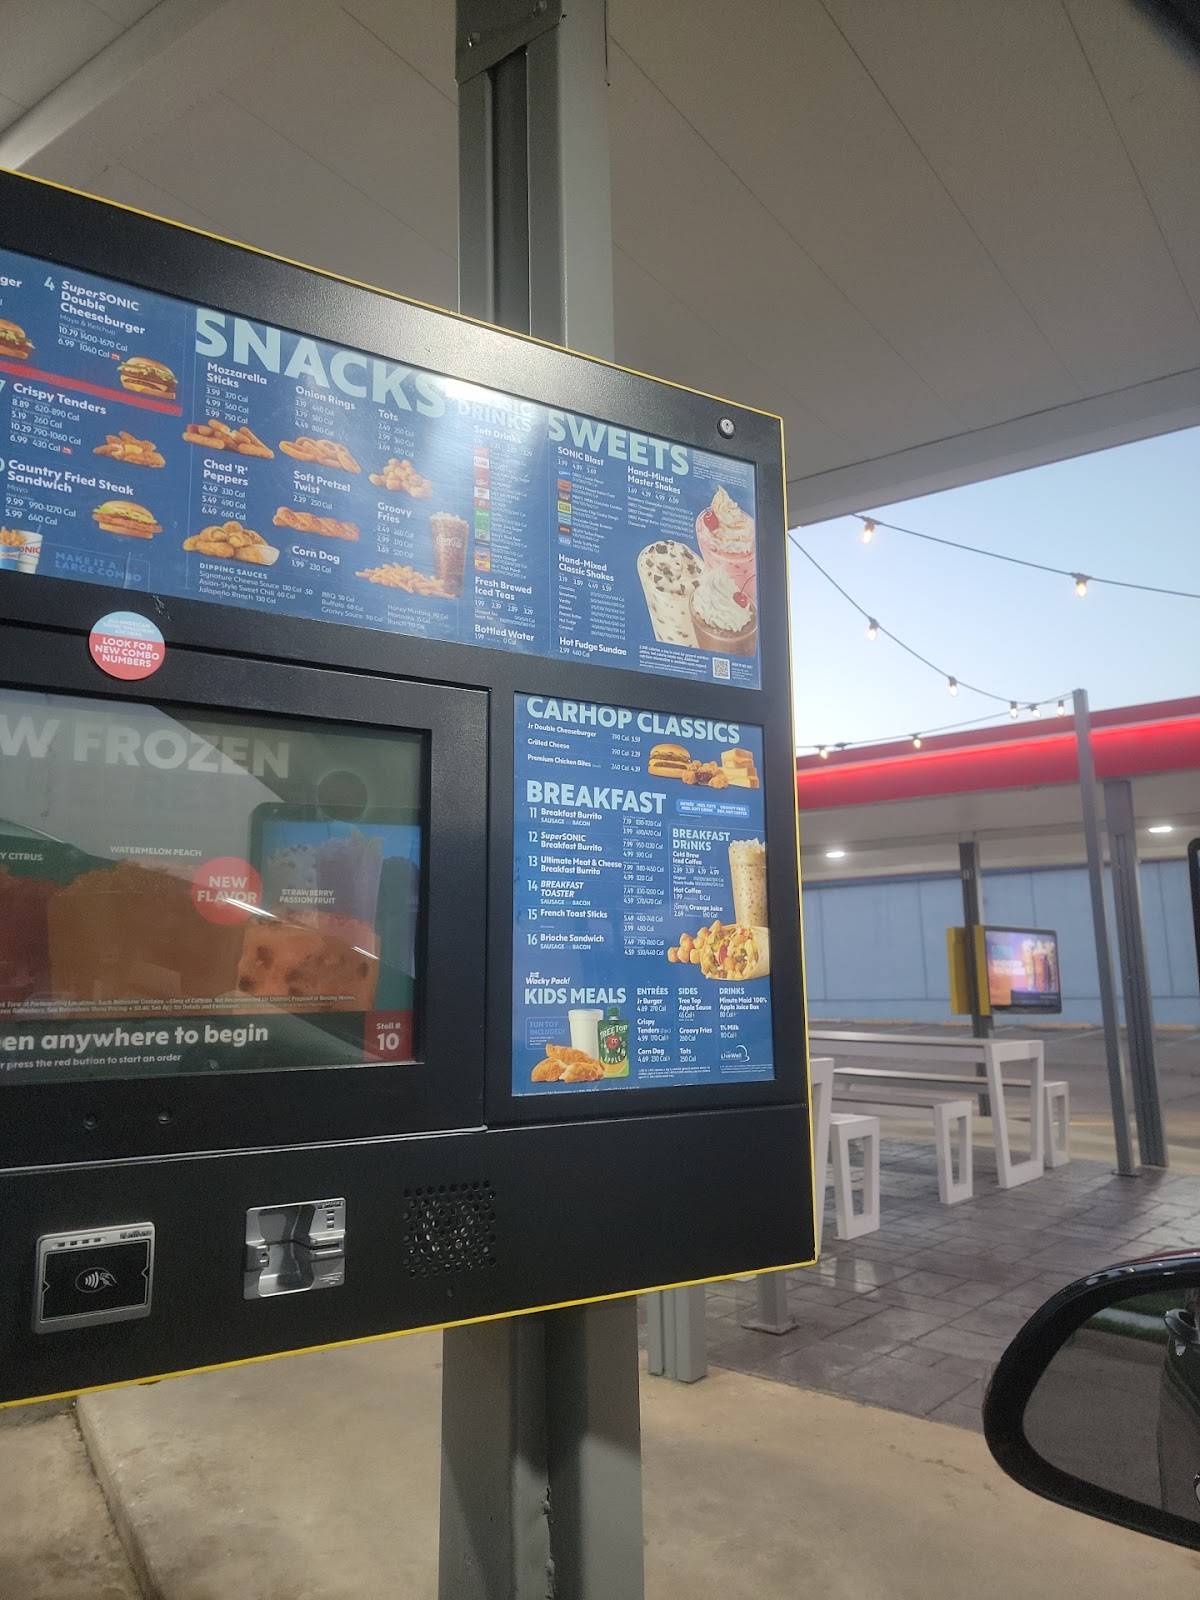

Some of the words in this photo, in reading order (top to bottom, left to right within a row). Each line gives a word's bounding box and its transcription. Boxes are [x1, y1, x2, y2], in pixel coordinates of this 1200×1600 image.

[43, 276, 55, 291] 4
[61, 280, 140, 312] SuperSONIC
[60, 291, 106, 313] Double
[60, 302, 146, 335] Cheeseburger
[195, 308, 447, 419] SNACKS
[206, 362, 268, 386] Mozzarella
[206, 373, 240, 390] Sticks
[13, 382, 55, 407] Crispy
[57, 389, 107, 415] Tenders
[295, 385, 326, 403] Onion
[328, 394, 356, 411] Rings
[378, 408, 400, 422] Tots
[547, 411, 690, 476] SWEETS
[557, 446, 585, 462] SONIC
[584, 454, 605, 467] Blast
[203, 459, 232, 474] Ched
[234, 462, 248, 475] 'R'
[627, 466, 674, 484] Hand-Mixed
[7, 471, 73, 494] Sandwich
[8, 458, 62, 481] Country
[64, 471, 96, 488] Fried
[98, 479, 135, 497] Steak
[203, 469, 249, 487] Peppers
[294, 470, 315, 484] Soft
[316, 476, 351, 494] Pretzel
[627, 475, 654, 489] Master
[654, 480, 681, 496] Shakes
[293, 480, 320, 496] Twist
[377, 502, 413, 519] Groovy
[377, 511, 401, 525] Fries
[56, 551, 90, 566] MAKE
[94, 558, 104, 568] IT
[109, 561, 116, 570] A
[292, 545, 318, 560] Corn
[319, 549, 341, 566] Dog
[558, 553, 608, 572] Hand-Mixed
[55, 560, 95, 575] LARGE
[96, 567, 143, 583] COMBO
[199, 562, 234, 575] DIPPING
[236, 568, 269, 581] SAUCES
[558, 563, 586, 577] Classic
[586, 569, 615, 582] Shakes
[474, 576, 499, 589] Fresh
[500, 580, 533, 595] Brewed
[474, 586, 494, 598] Iced
[495, 588, 516, 601] Teas
[474, 624, 507, 638] Bottled
[507, 629, 535, 643] Water
[103, 636, 132, 649] LOOK
[134, 641, 154, 652] FOR
[559, 636, 574, 648] Hot
[575, 639, 599, 653] Fudge
[599, 643, 628, 656] Sundae
[95, 644, 121, 656] NEW
[122, 648, 161, 661] COMBO
[102, 653, 152, 669] NUMBERS
[526, 696, 633, 729] CARHOP
[637, 710, 741, 746] CLASSICS
[534, 723, 556, 733] Double
[556, 727, 597, 739] Cheeseburger
[73, 721, 290, 781] FROZEN
[527, 738, 548, 748] Grilled
[548, 740, 570, 750] Cheese
[527, 753, 554, 764] Premium
[554, 757, 577, 766] Chicken
[577, 759, 592, 768] Bites
[527, 779, 667, 815] BREAKFAST
[529, 807, 537, 818] 11
[540, 808, 576, 820] Breakfast
[577, 811, 603, 821] Burrito
[541, 817, 565, 825] SAUSAGE
[528, 831, 538, 843] 12
[540, 831, 587, 843] SuperSONIC
[672, 827, 731, 842] BREAKFAST
[110, 845, 171, 857] WATERMELON
[173, 848, 204, 858] PEACH
[540, 841, 577, 852] Breakfast
[577, 843, 603, 853] Burrito
[672, 839, 712, 852] DRINKS
[8, 852, 45, 862] CITRUS
[528, 855, 538, 867] 13
[540, 855, 572, 867] Ultimate
[572, 859, 591, 868] Meat
[597, 861, 623, 871] Cheese
[540, 865, 576, 875] Breakfast
[576, 867, 601, 877] Burrito
[208, 876, 249, 890] NEW
[527, 880, 538, 892] 14
[540, 880, 585, 891] BREAKFAST
[673, 885, 684, 894] Hot
[684, 886, 702, 894] Coffee
[197, 890, 258, 905] FLAVOR
[279, 895, 313, 905] PASSION
[280, 888, 335, 897] STRAWBERRY
[540, 889, 576, 899] TOASTER
[540, 898, 565, 906] SAUSAGE
[528, 908, 538, 921] 15
[540, 908, 566, 918] French
[566, 910, 587, 918] Toast
[587, 911, 608, 920] Sticks
[527, 933, 538, 946] 16
[540, 933, 568, 943] Brioche
[569, 935, 605, 944] Sandwich
[540, 943, 565, 951] SAUSAGE
[526, 976, 550, 987] Wacky
[525, 987, 568, 1005] KIDS
[570, 987, 627, 1005] MEALS
[636, 986, 669, 996] ENTRÉES
[678, 987, 699, 996] SIDES
[719, 986, 746, 996] DRINKS
[644, 998, 664, 1006] Burger
[719, 997, 739, 1005] Minute
[738, 997, 753, 1005] Maid
[719, 1004, 735, 1012] Apple
[376, 1021, 395, 1031] Stall
[637, 1017, 656, 1026] Crispy
[41, 1027, 170, 1054] anywhere
[174, 1025, 199, 1045] to
[204, 1022, 270, 1049] begin
[638, 1026, 660, 1035] Tenders
[679, 1027, 700, 1035] Groovy
[699, 1026, 713, 1034] Fries
[377, 1031, 401, 1051] 10
[637, 1048, 652, 1056] Corn
[652, 1048, 665, 1056] Dog
[6, 1059, 34, 1071] press
[36, 1058, 53, 1068] the
[54, 1057, 71, 1067] red
[73, 1053, 106, 1066] button
[108, 1055, 118, 1064] to
[119, 1054, 142, 1063] start
[143, 1055, 156, 1063] an
[156, 1052, 183, 1062] order
